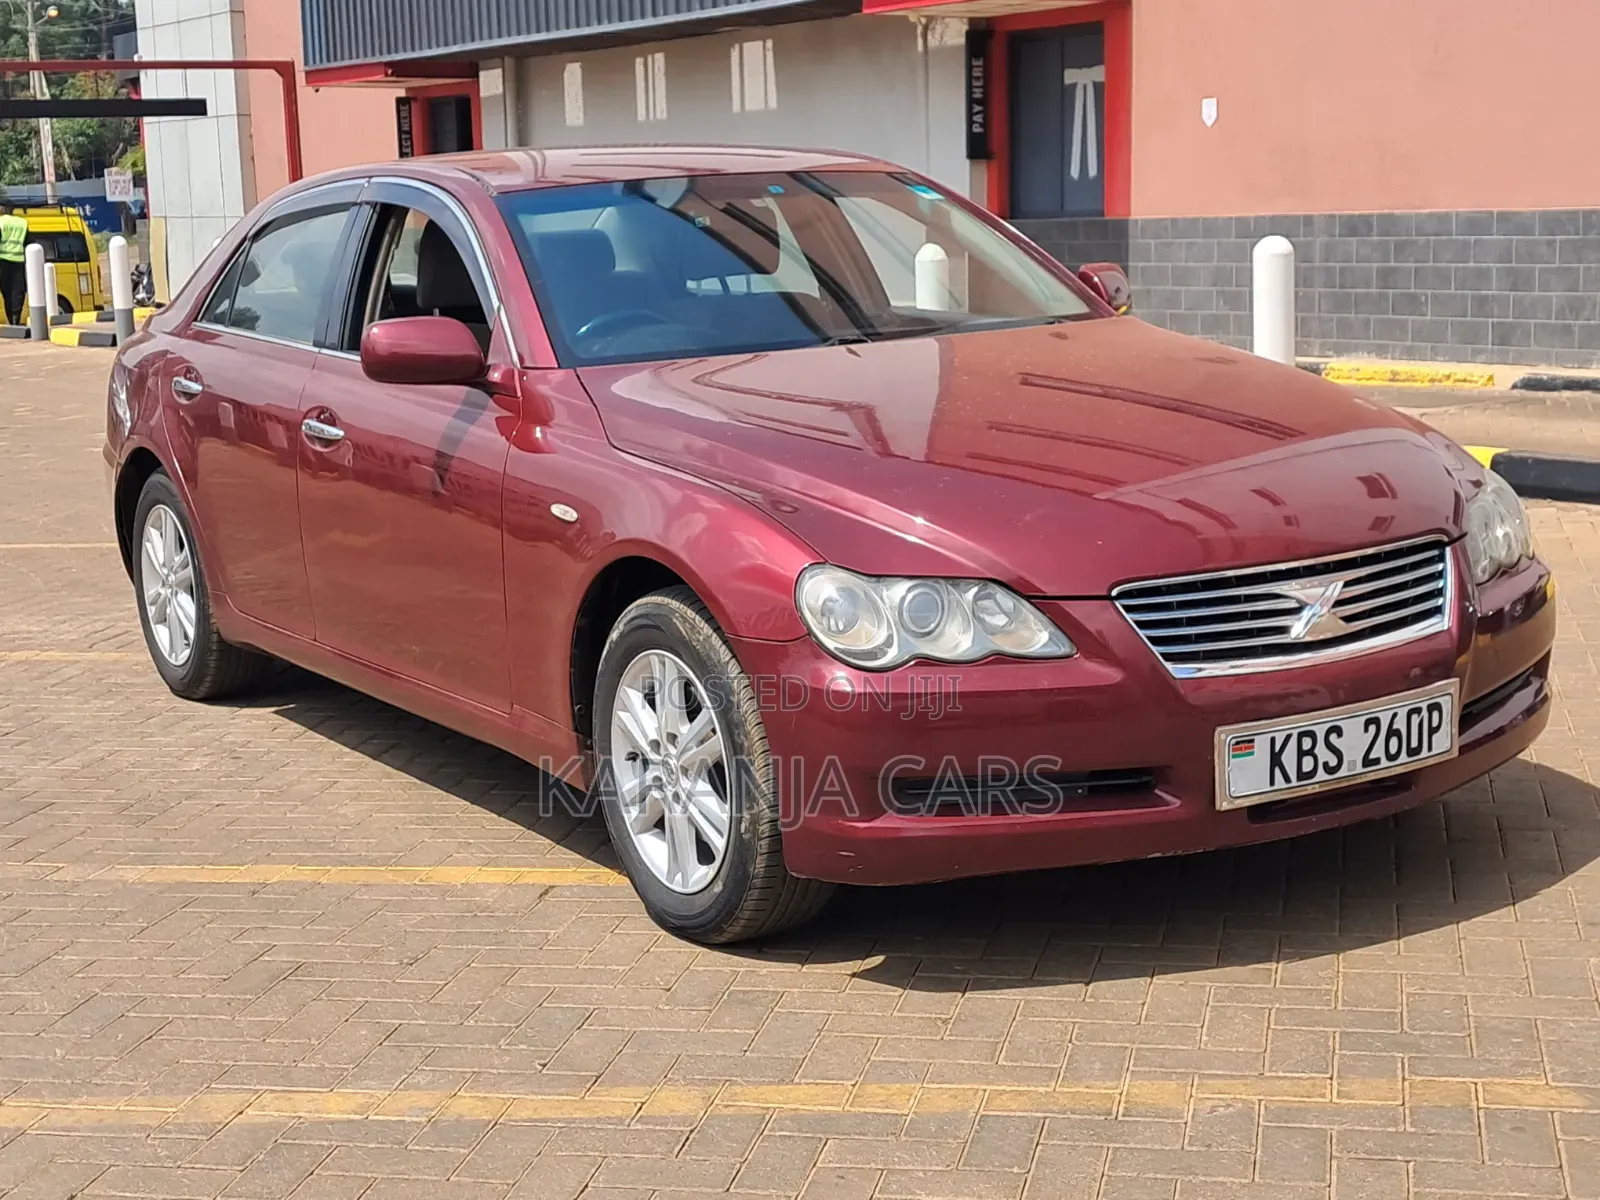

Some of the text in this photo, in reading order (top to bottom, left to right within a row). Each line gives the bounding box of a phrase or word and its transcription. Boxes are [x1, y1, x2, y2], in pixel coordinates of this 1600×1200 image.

[972, 57, 984, 133] PAY HERE
[1269, 701, 1444, 787] KBS 260P
